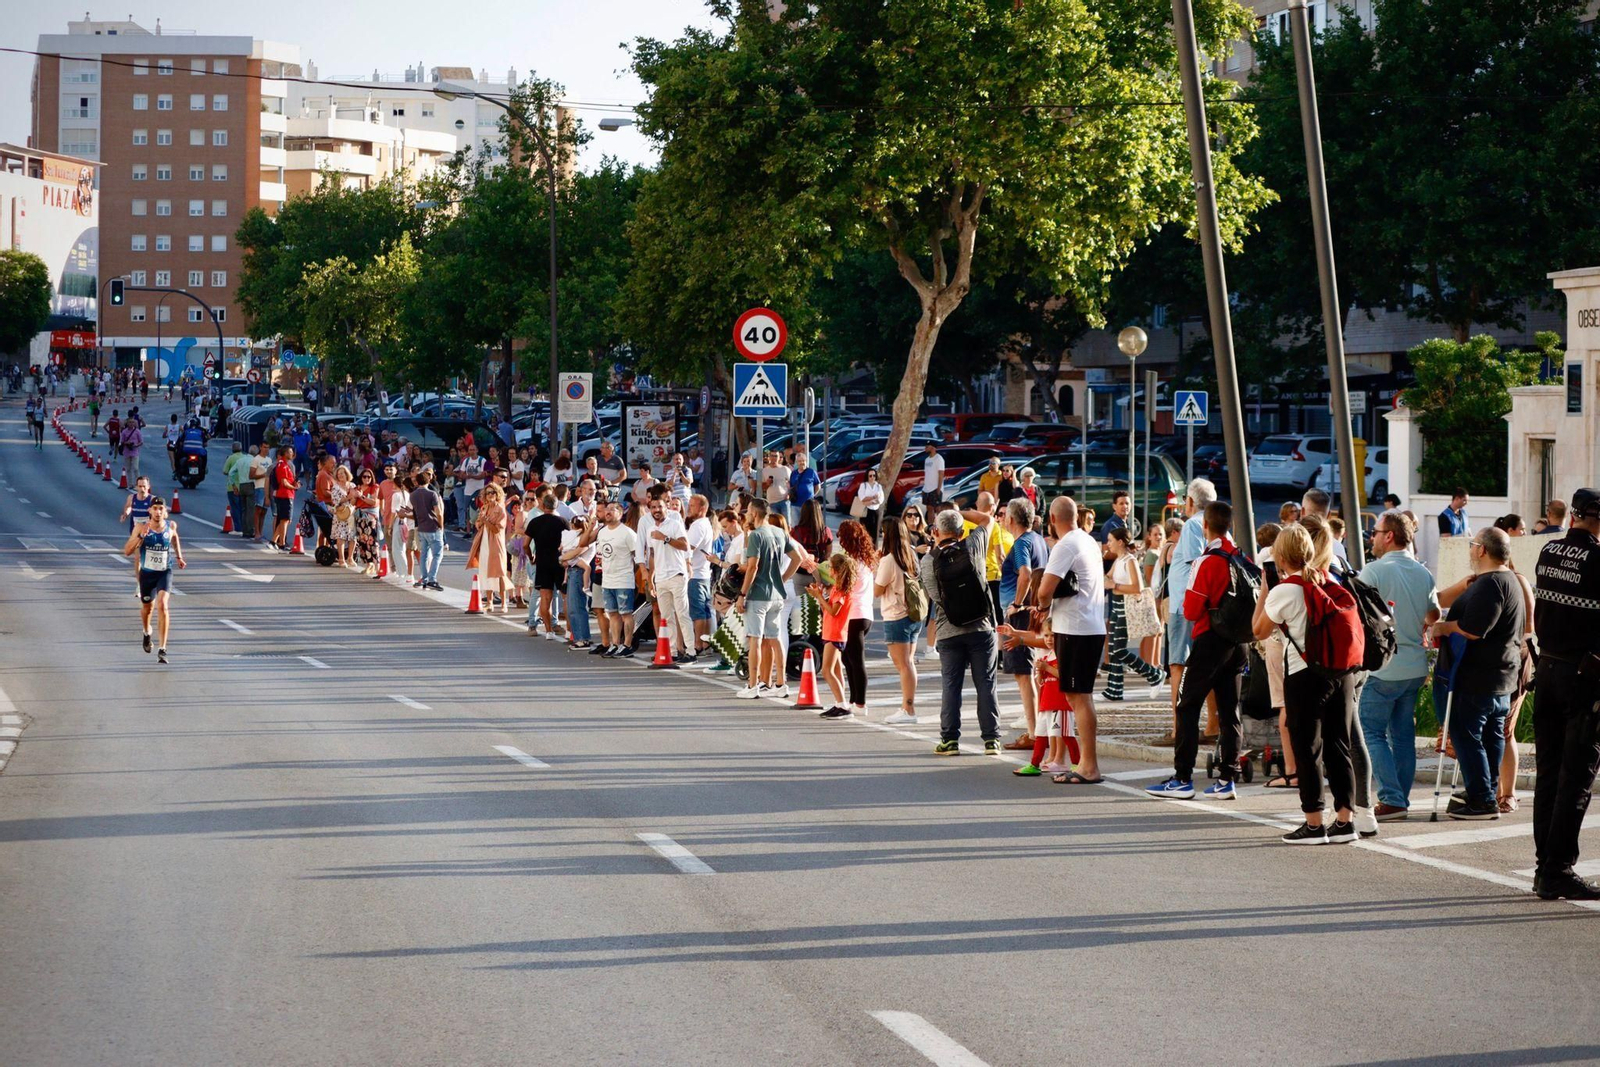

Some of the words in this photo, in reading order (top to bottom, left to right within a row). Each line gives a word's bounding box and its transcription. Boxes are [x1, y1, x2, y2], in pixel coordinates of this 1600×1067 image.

[1578, 308, 1600, 329] OBSE
[744, 326, 777, 344] 40
[633, 409, 641, 419] 5
[630, 428, 653, 438] King
[638, 437, 671, 445] Ahorro
[1542, 542, 1590, 561] POLICIA
[150, 556, 163, 564] 703
[1560, 559, 1580, 570] LOCAL
[1546, 566, 1582, 584] FERNANDO
